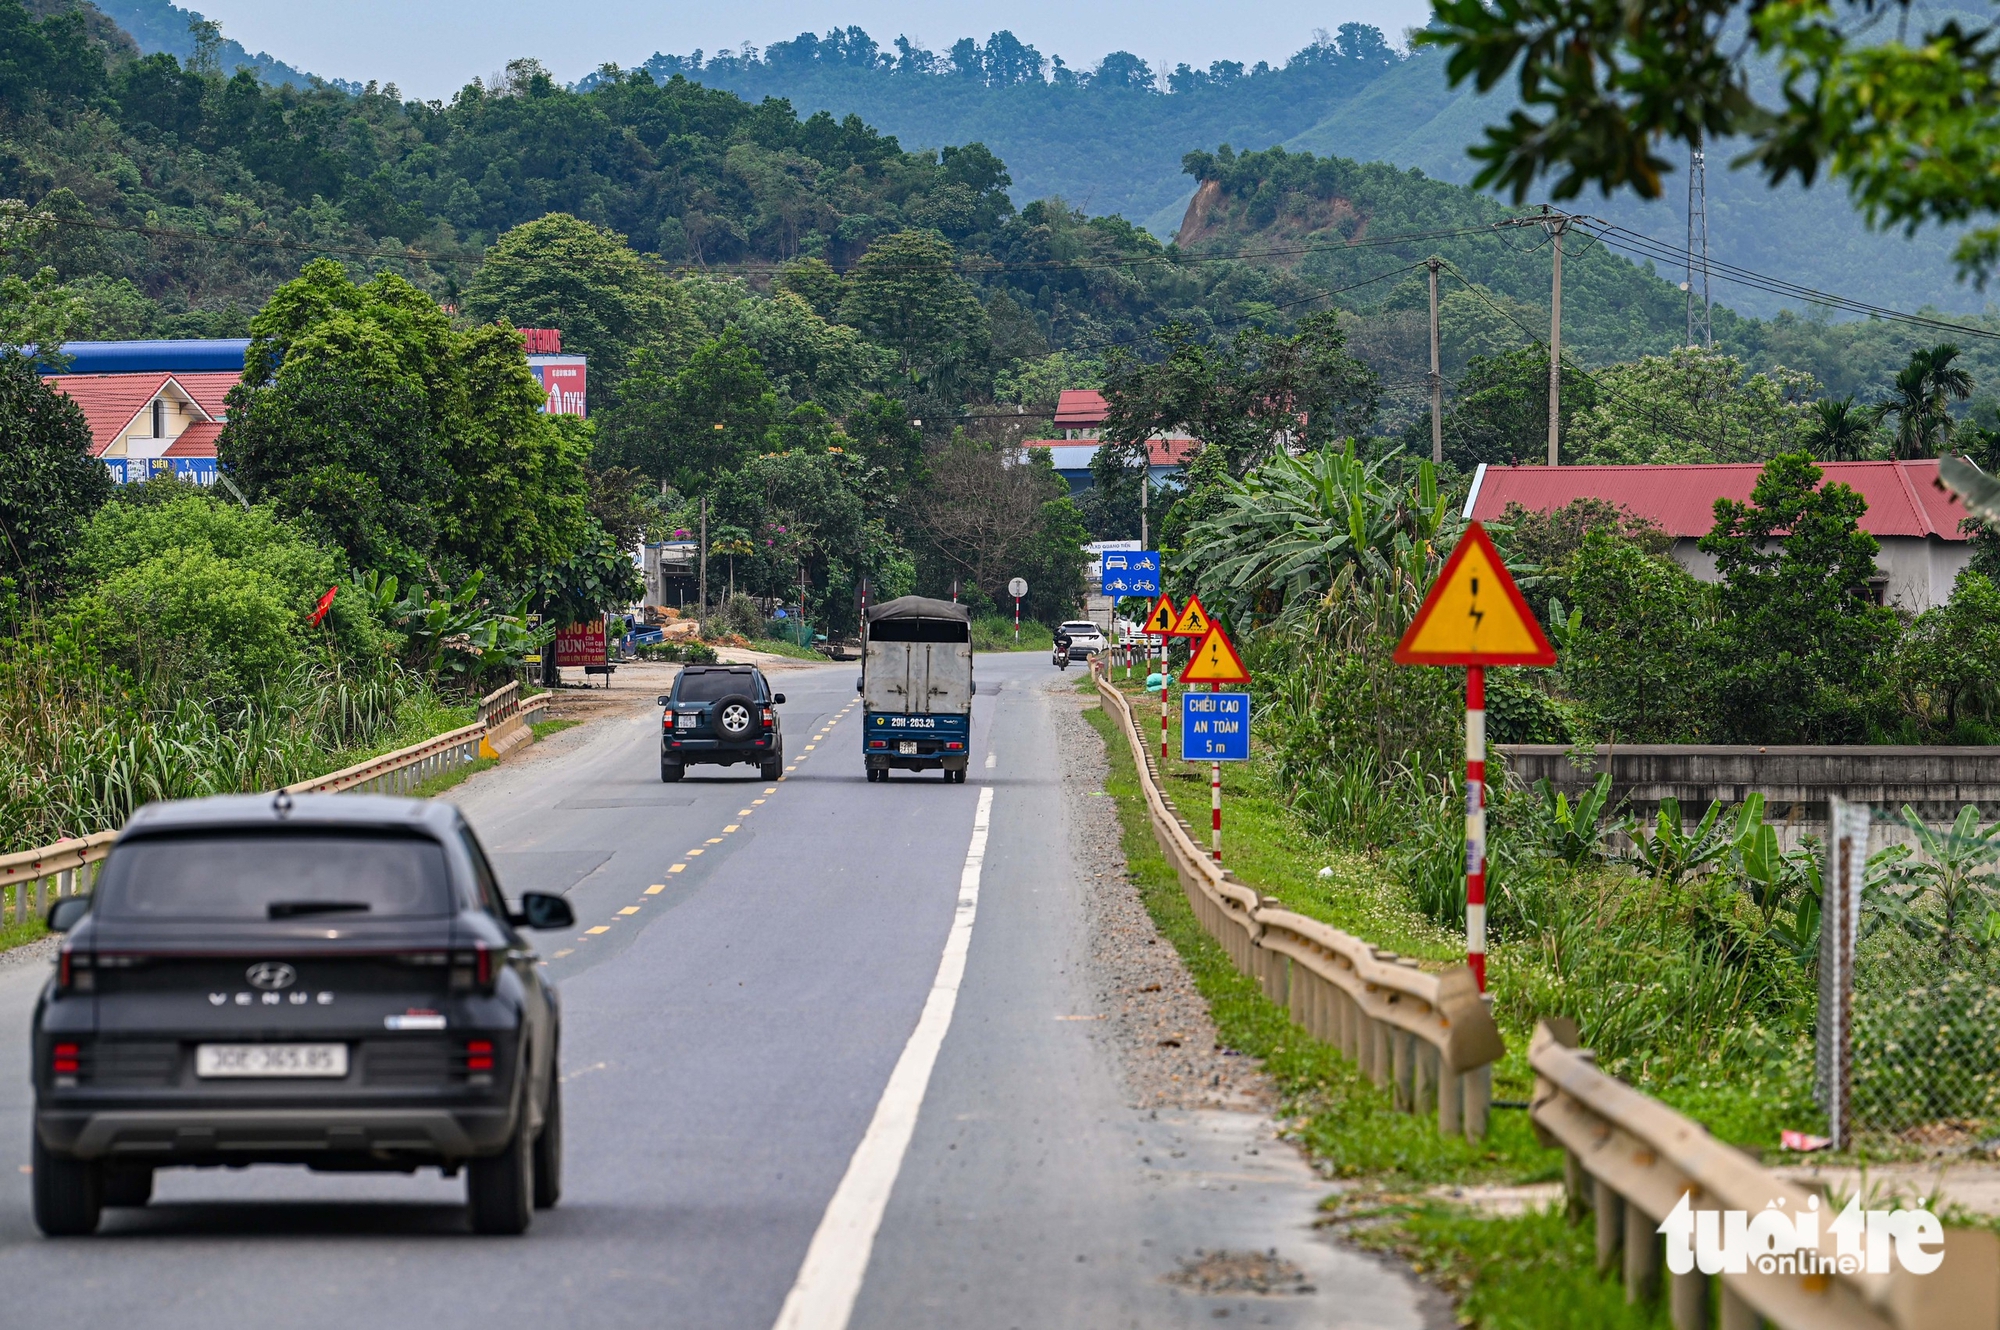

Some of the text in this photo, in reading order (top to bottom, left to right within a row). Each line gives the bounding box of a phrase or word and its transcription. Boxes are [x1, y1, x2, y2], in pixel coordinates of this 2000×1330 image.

[558, 635, 581, 653] BÚN
[1189, 695, 1239, 713] CHIỀU CAO
[1194, 718, 1239, 733] AN TOÀN
[1206, 740, 1225, 753] 5 m
[208, 991, 335, 1006] VENUE
